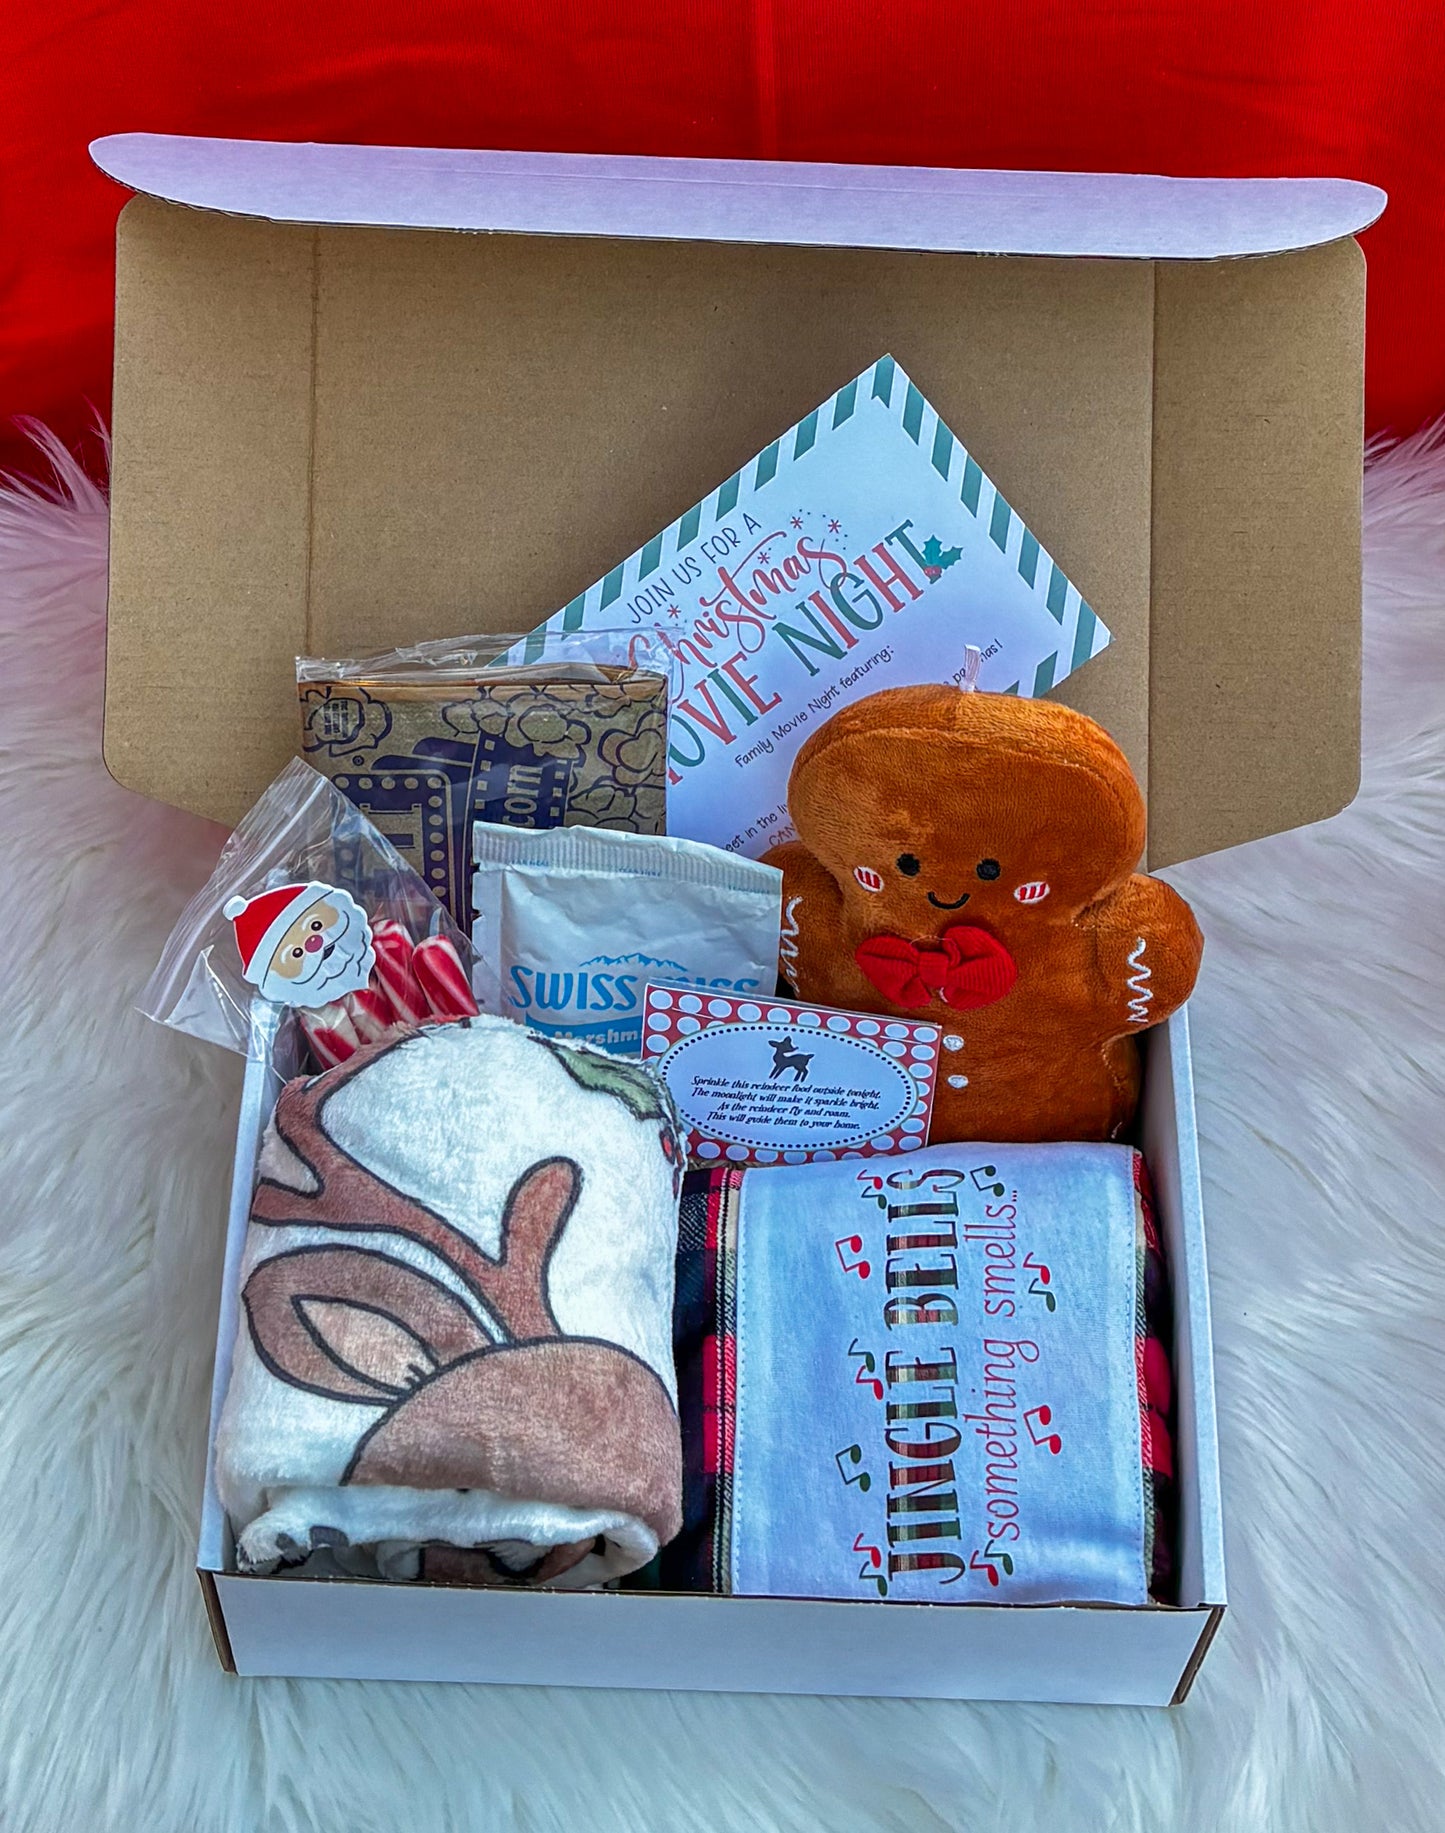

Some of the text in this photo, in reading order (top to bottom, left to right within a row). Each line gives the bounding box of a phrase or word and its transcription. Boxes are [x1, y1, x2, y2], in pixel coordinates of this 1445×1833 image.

[626, 512, 762, 624] JOIN US FOR A
[667, 519, 943, 785] OVIE NIGHT
[735, 645, 895, 768] Family Movie Night featuring:
[744, 826, 759, 839] in
[756, 813, 778, 829] the
[508, 965, 639, 1011] SWISS
[691, 1075, 881, 1099] Sprinkle this reindeer food outside tonight.
[691, 1086, 880, 1110] The moonlight will make it sparkle bright.
[717, 1101, 851, 1118] As the reindeer fly and roam.
[707, 1111, 861, 1130] This will guide them to your home.
[883, 1168, 966, 1585] JINGLE BELLS
[963, 1189, 1040, 1542] something smells...
